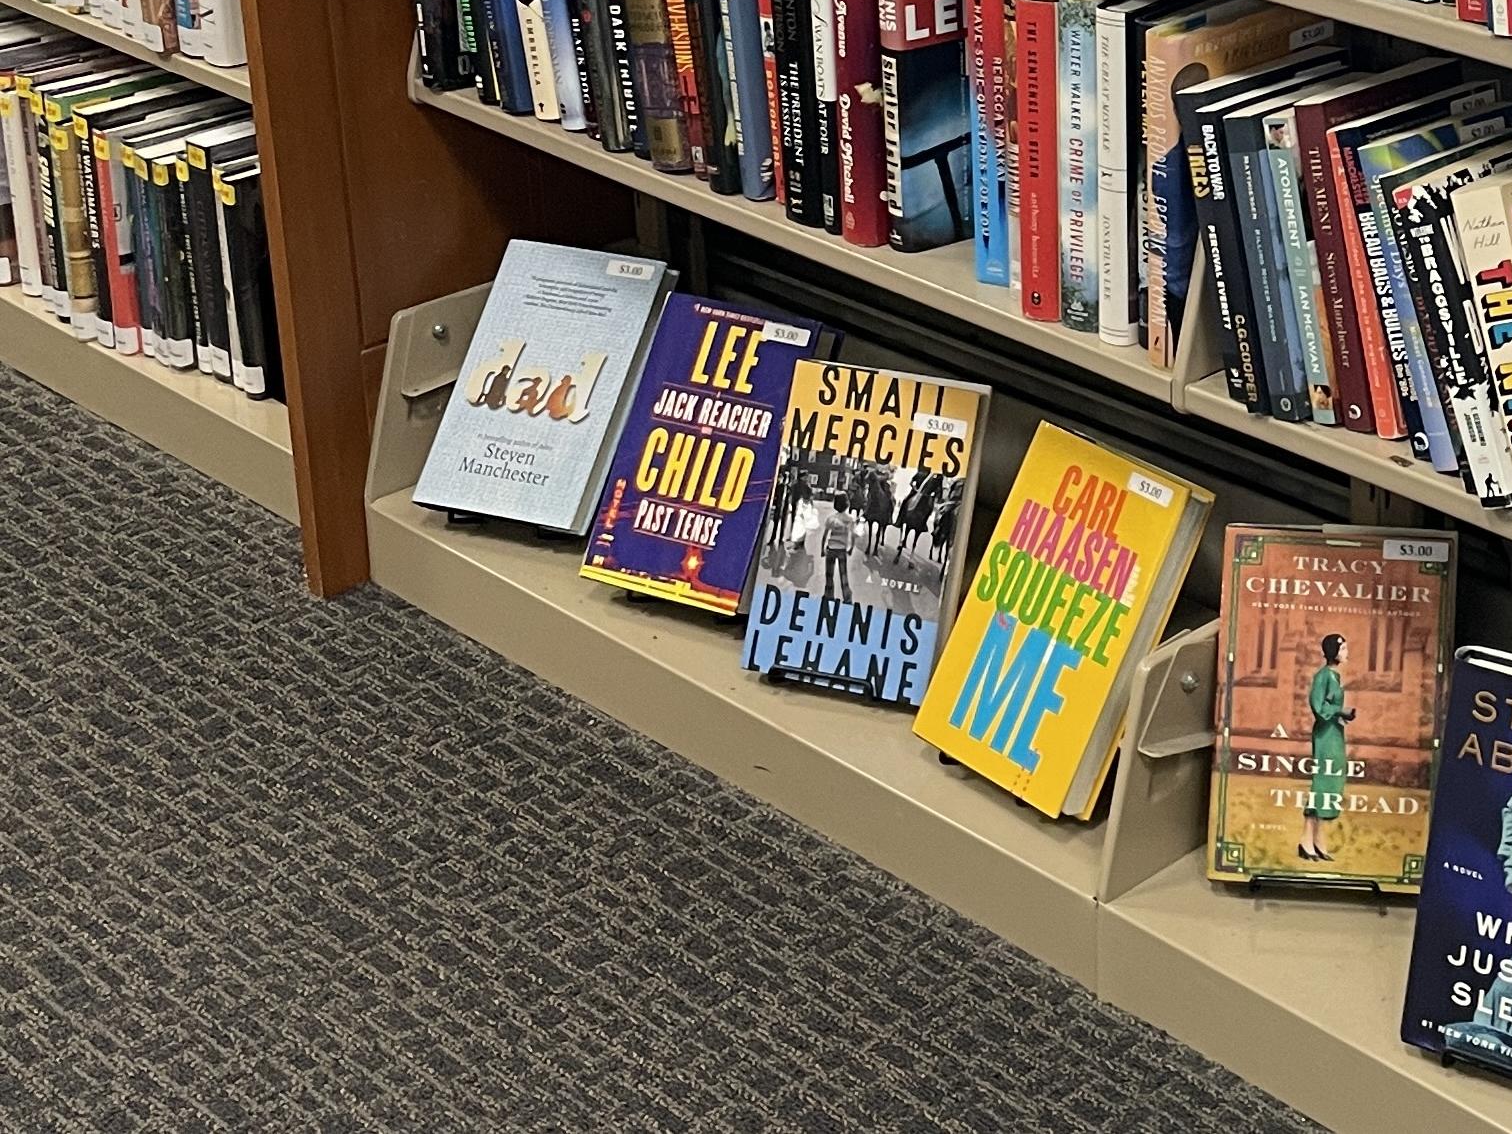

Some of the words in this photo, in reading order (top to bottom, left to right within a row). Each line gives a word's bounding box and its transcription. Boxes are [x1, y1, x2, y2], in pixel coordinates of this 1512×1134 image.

[620, 264, 643, 276] $3.00
[773, 327, 798, 342] $3.00
[690, 320, 767, 395] LEE
[465, 338, 608, 426] dad
[654, 388, 697, 421] JACK
[701, 395, 772, 439] REACHER
[927, 419, 954, 433] $3.00
[484, 441, 535, 466] Steven
[789, 407, 964, 478] MERCIES
[458, 455, 550, 488] Manchester
[634, 427, 756, 513] CHILD
[1053, 464, 1128, 541] CARL
[1138, 481, 1163, 499] $3.00
[633, 499, 672, 534] PAST
[673, 511, 723, 547] TENSE
[1008, 499, 1140, 602] HIAASEN
[1400, 545, 1433, 556] $3.00
[1293, 556, 1387, 576] TRACY
[881, 580, 919, 594] NOVEL
[1245, 576, 1432, 604] CHEVALIER
[976, 541, 1130, 668] SQUEEZE
[759, 591, 923, 656] DENNIS
[749, 629, 918, 704] LEHANE
[949, 615, 1085, 774] ME
[1271, 724, 1288, 739] A
[1237, 753, 1367, 778] SINGLE
[1270, 788, 1420, 815] THREAD
[1443, 862, 1451, 871] A
[1454, 866, 1484, 881] NOVEL
[1438, 1025, 1463, 1038] NEW
[1466, 1035, 1497, 1051] YORK
